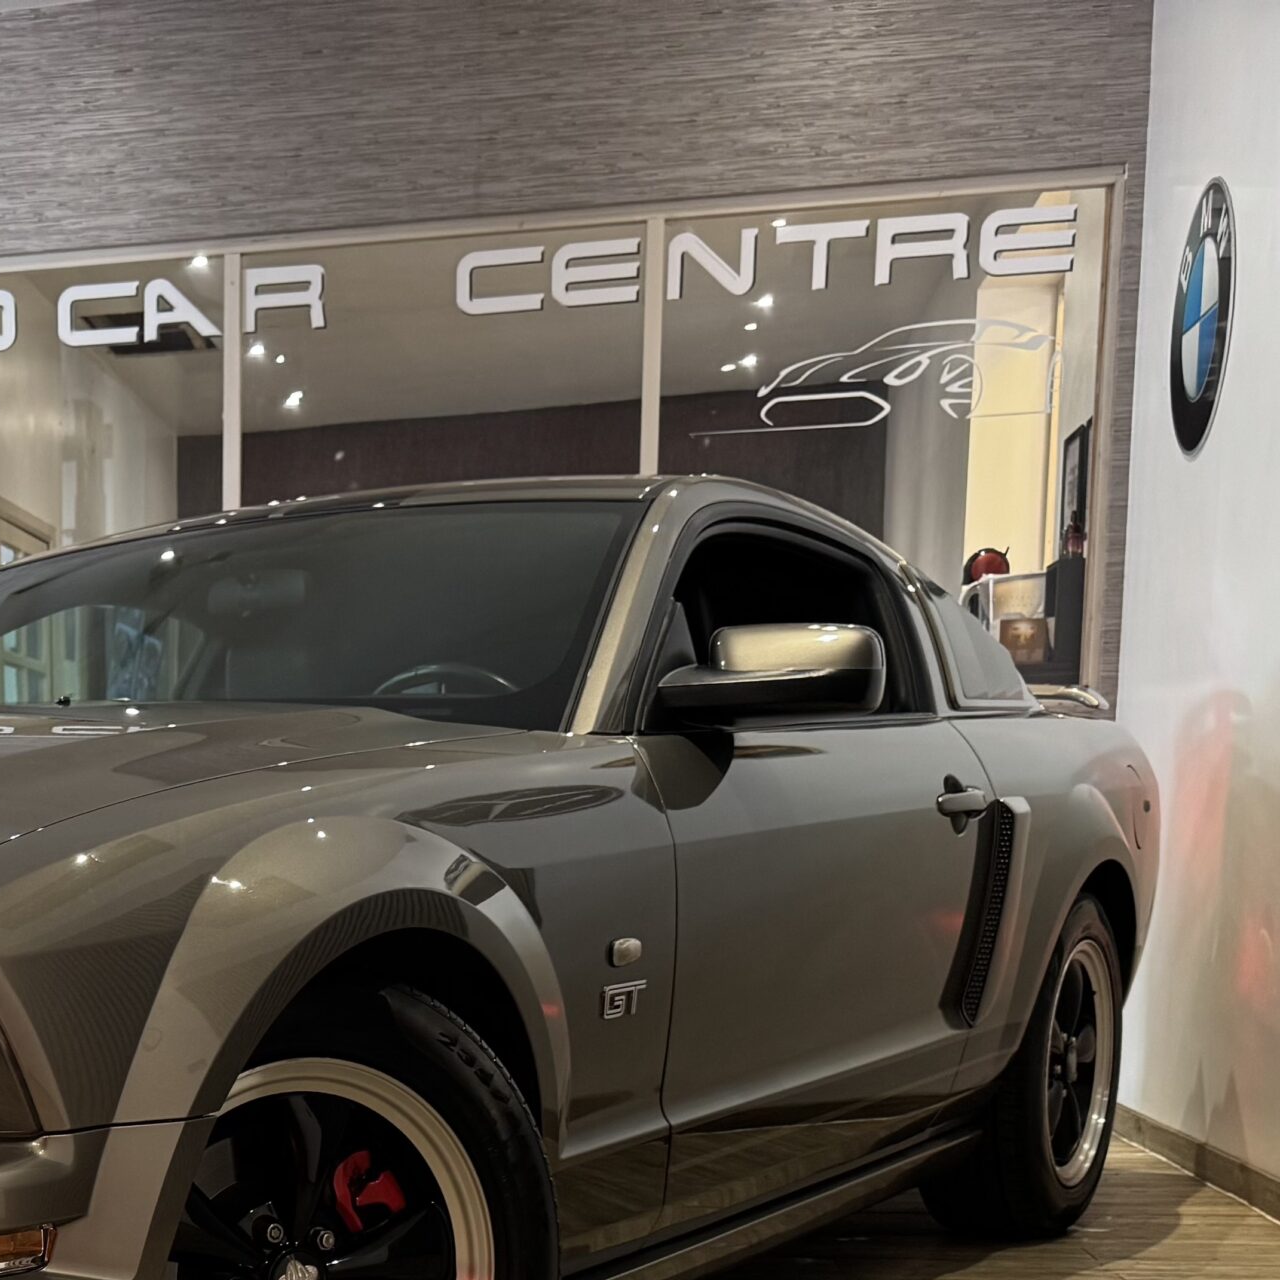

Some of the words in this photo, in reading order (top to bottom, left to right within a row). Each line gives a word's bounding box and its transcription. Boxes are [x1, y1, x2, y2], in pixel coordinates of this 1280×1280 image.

[57, 264, 326, 347] CAR
[455, 204, 1079, 315] CENTRE
[1180, 189, 1229, 294] BMW
[602, 979, 647, 1019] GT
